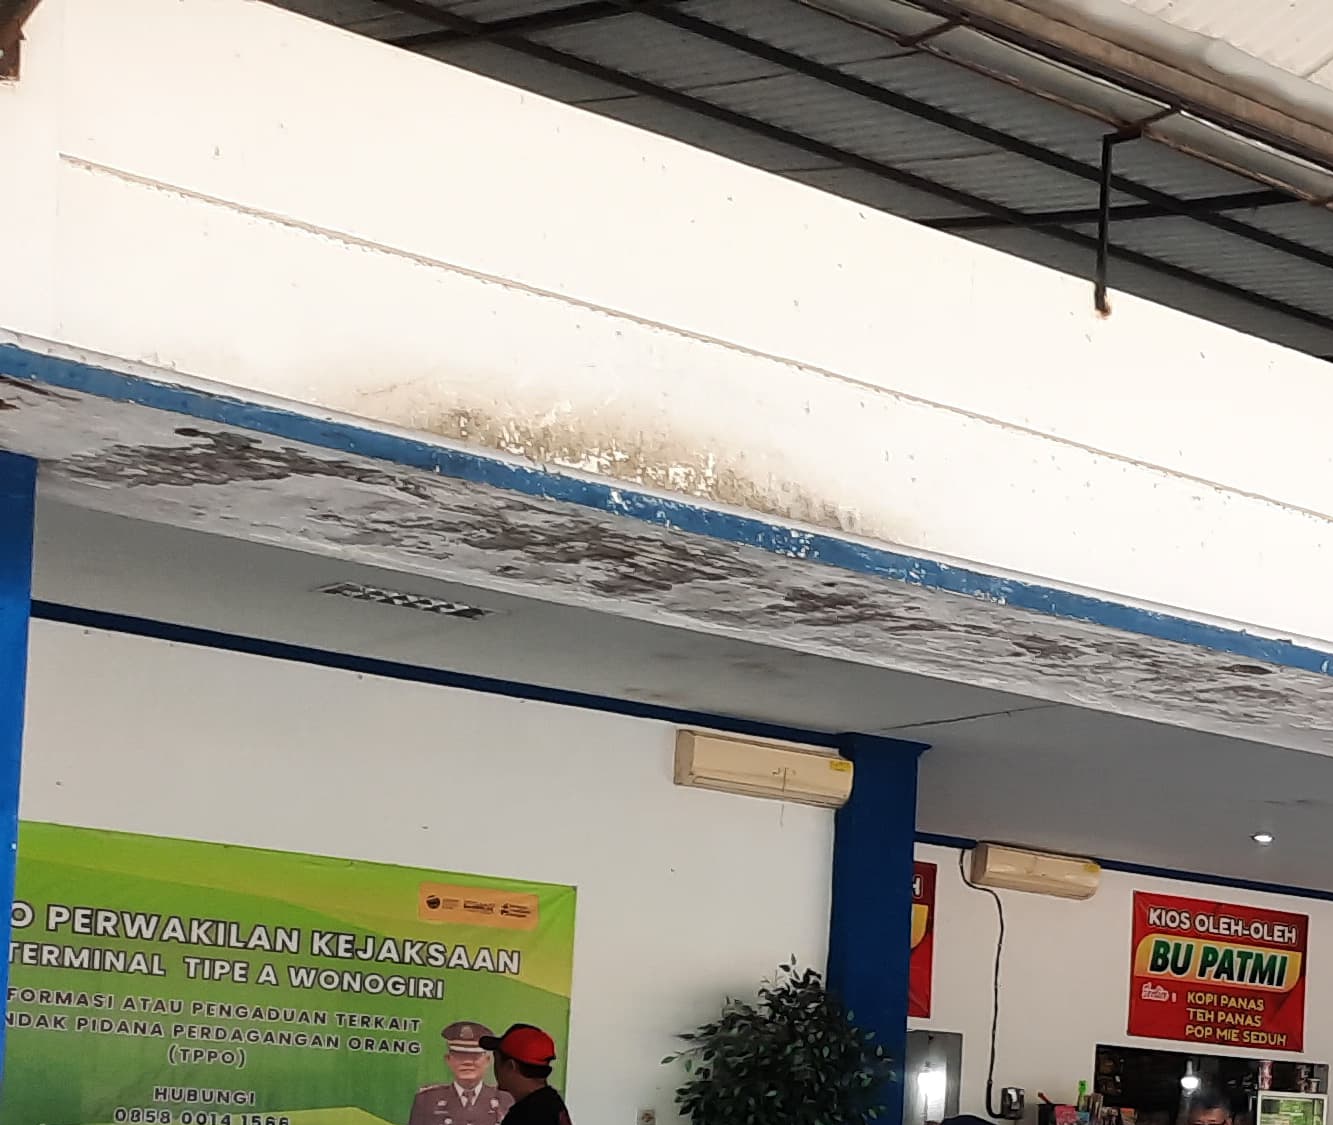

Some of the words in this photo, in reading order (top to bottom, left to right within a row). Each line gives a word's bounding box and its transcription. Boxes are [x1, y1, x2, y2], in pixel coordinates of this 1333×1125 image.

[46, 904, 299, 953] PERWAKILAN
[311, 930, 521, 974] KEJAKSAAN
[1149, 908, 1191, 930] KIOS
[1195, 914, 1296, 943] OLEH-OLEH
[183, 956, 249, 983] TIPE
[256, 963, 279, 986] A
[288, 966, 444, 1000] WONOGIRI
[1149, 939, 1194, 976] BU
[1197, 946, 1288, 988] PATMI
[7, 987, 114, 1009] FORMASI
[123, 996, 183, 1015] ATAU
[192, 1001, 327, 1025] PENGADUAN
[336, 1013, 421, 1032] TERKAIT
[1187, 992, 1217, 1006] KOPI
[1220, 996, 1264, 1011] PANAS
[1187, 1008, 1214, 1021] TEH
[1218, 1012, 1262, 1027] PANAS
[5, 1013, 66, 1031] NDAK
[76, 1017, 163, 1038] PIDANA
[173, 1024, 339, 1048] PERDAGANGAN
[348, 1037, 421, 1055] ORANG
[1186, 1025, 1212, 1039] POP
[1216, 1029, 1240, 1042] MIE
[1243, 1031, 1287, 1046] SEDUH
[168, 1045, 246, 1067] (TPPO)
[153, 1087, 256, 1106] HUBUNGI
